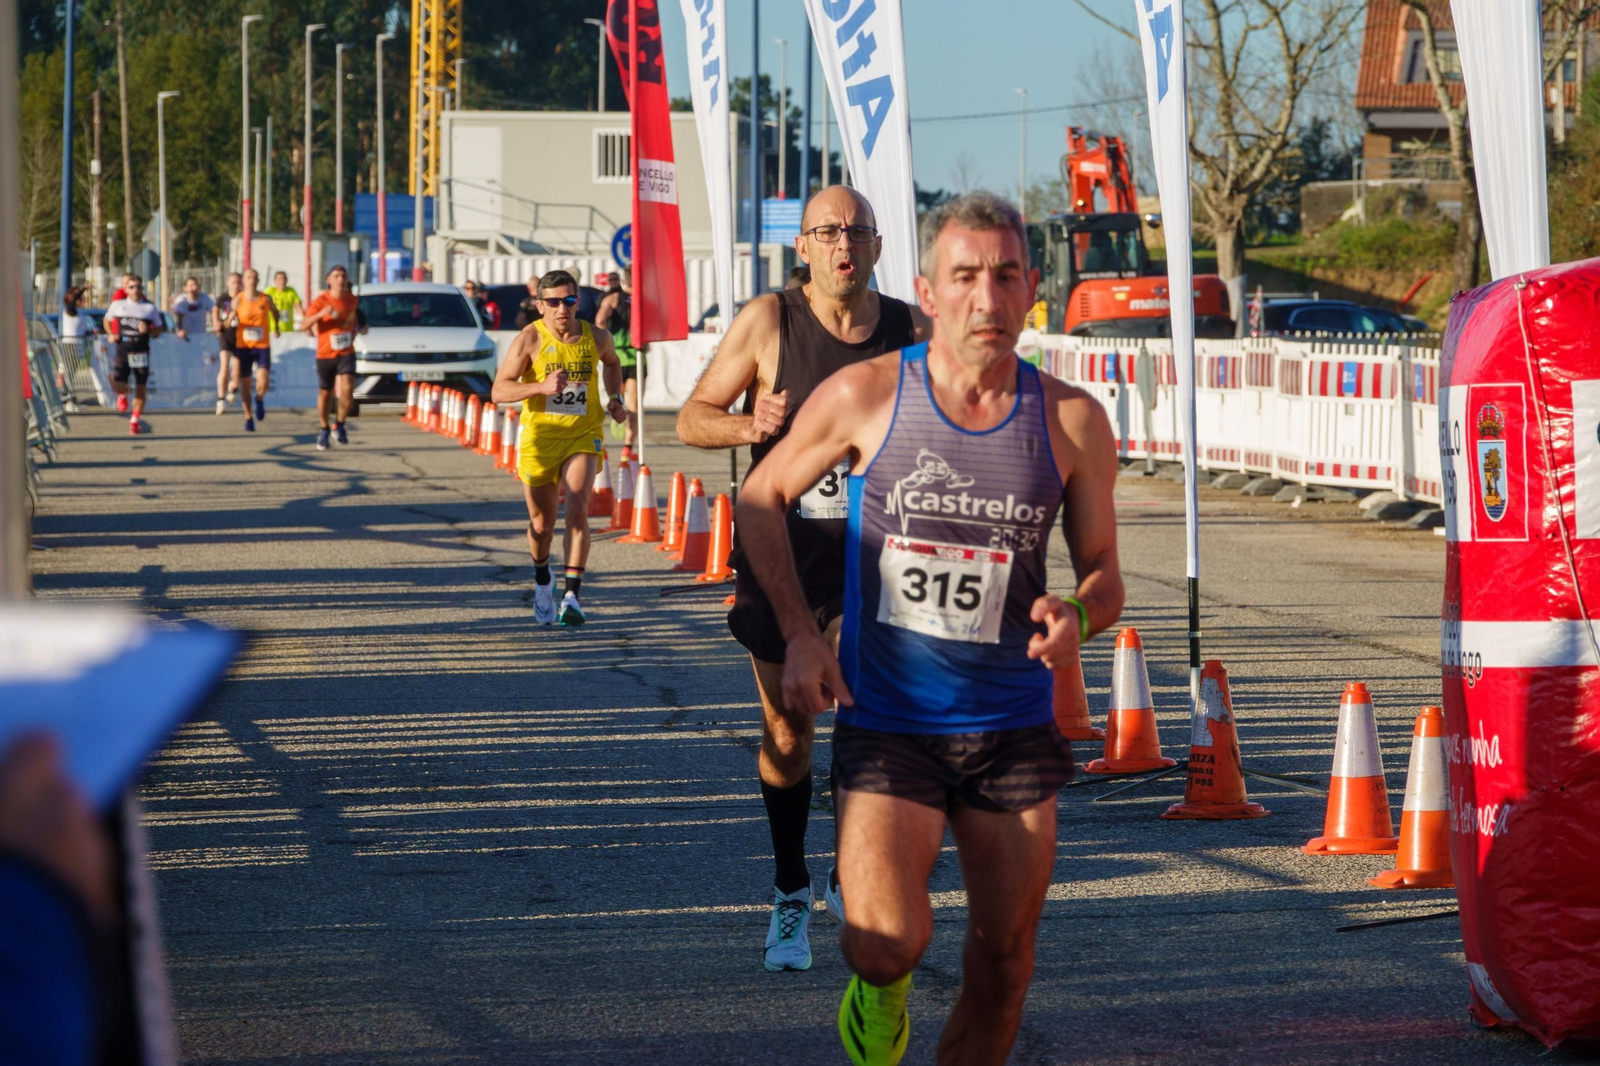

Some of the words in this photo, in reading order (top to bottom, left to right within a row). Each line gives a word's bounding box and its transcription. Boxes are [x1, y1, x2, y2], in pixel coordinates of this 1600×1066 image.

[639, 168, 674, 182] NCELLO
[649, 181, 670, 194] VIGO
[545, 361, 592, 372] ATHLETICS
[552, 391, 587, 406] 324
[904, 491, 1047, 524] castrelos
[902, 567, 982, 611] 315
